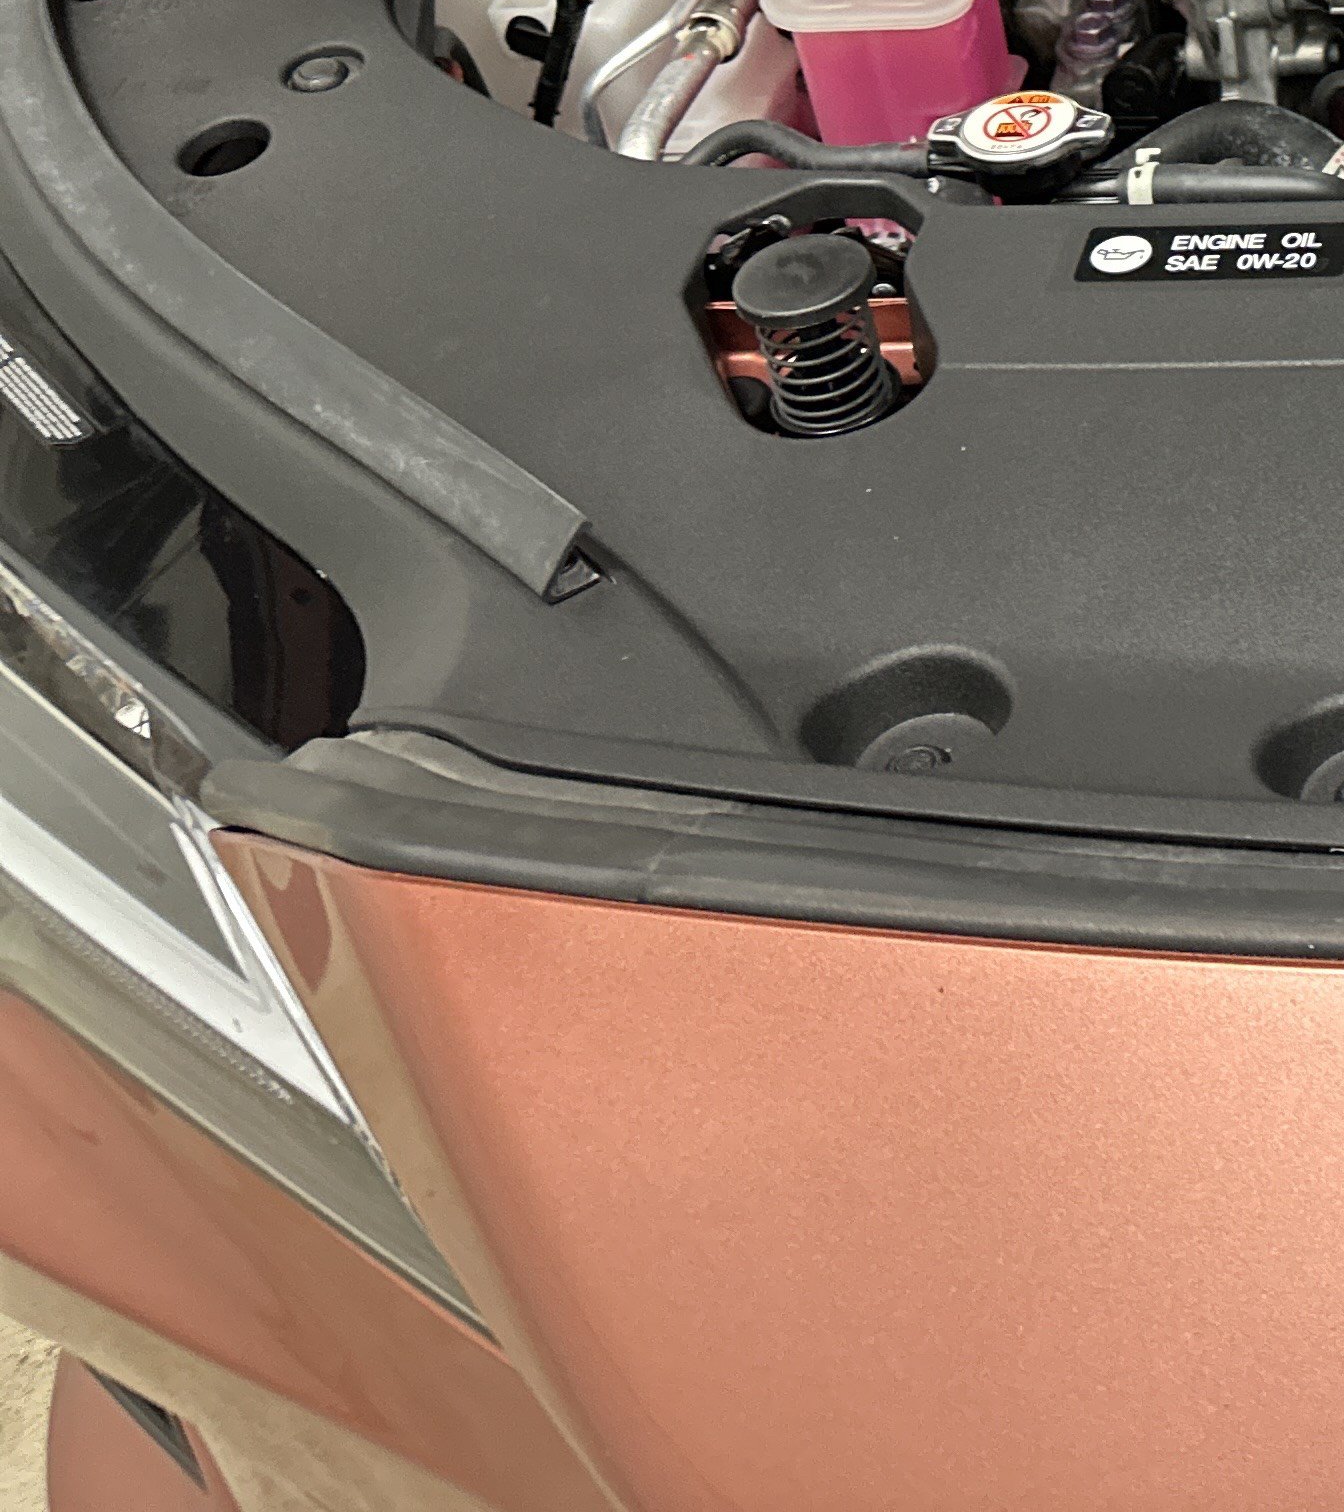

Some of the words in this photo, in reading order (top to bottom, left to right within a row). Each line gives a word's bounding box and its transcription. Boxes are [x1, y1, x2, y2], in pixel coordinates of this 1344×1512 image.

[1170, 234, 1267, 251] ENGINE
[1282, 232, 1323, 249] OIL
[1164, 255, 1221, 272] SAE
[1237, 253, 1317, 270] 0W-20
